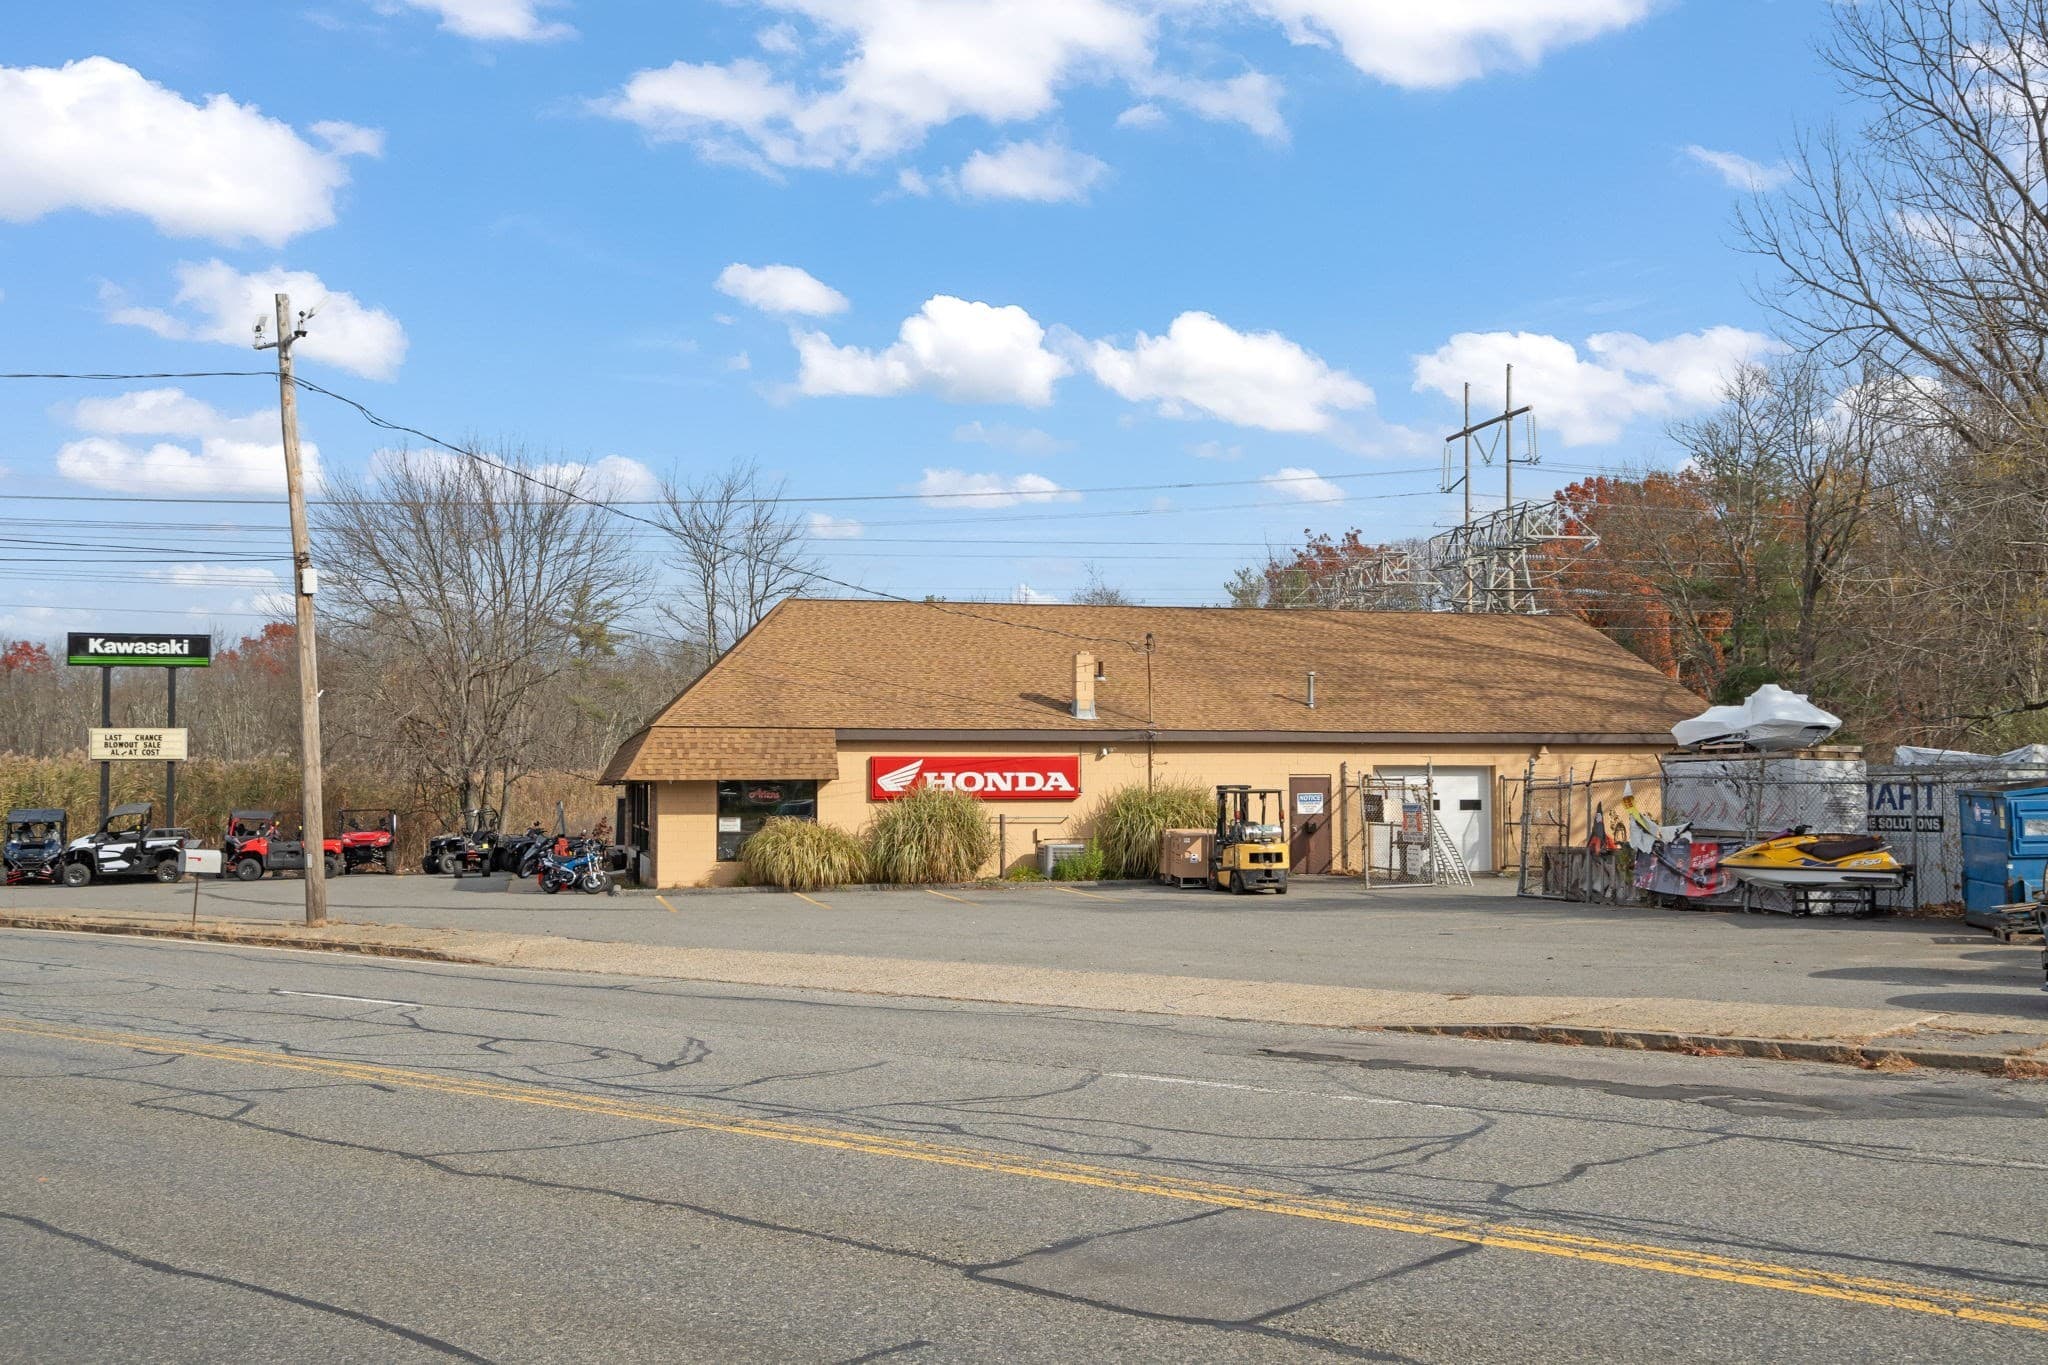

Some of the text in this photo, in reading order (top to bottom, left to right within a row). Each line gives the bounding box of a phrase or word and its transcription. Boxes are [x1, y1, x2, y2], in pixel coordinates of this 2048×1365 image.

[88, 638, 189, 654] Kawasaki
[923, 772, 1075, 791] HONDA
[1878, 817, 1941, 830] SOLUTONS
